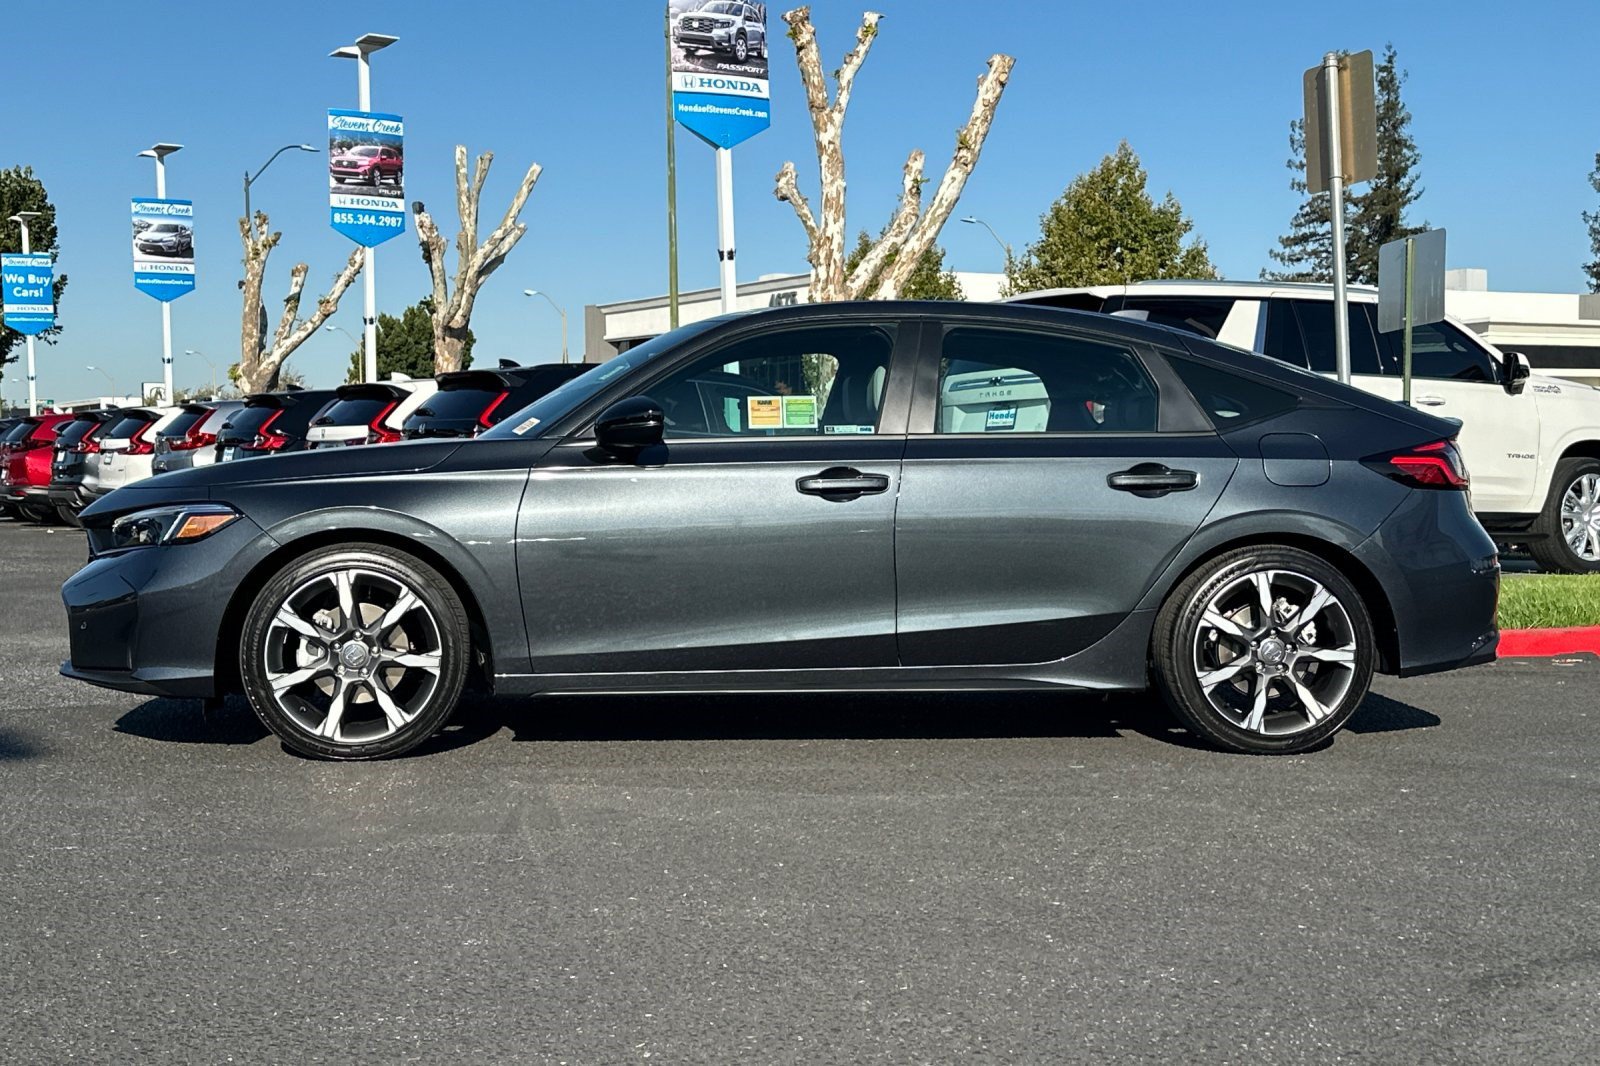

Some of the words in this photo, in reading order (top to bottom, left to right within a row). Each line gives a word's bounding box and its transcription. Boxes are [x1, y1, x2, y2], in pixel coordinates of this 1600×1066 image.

[716, 62, 765, 75] PASSPORT
[698, 77, 763, 94] HONDA
[678, 103, 768, 119] HondaofStevensCreek.com
[331, 115, 370, 132] Stevens
[372, 119, 402, 134] Creek
[378, 188, 402, 196] PILOT
[350, 198, 399, 209] HONDA
[333, 212, 402, 228] 855.344.2987
[149, 264, 190, 272] HONDA
[4, 273, 25, 284] We
[28, 274, 51, 287] Buy
[12, 286, 44, 298] Cars!
[979, 389, 1013, 399] TAHOE
